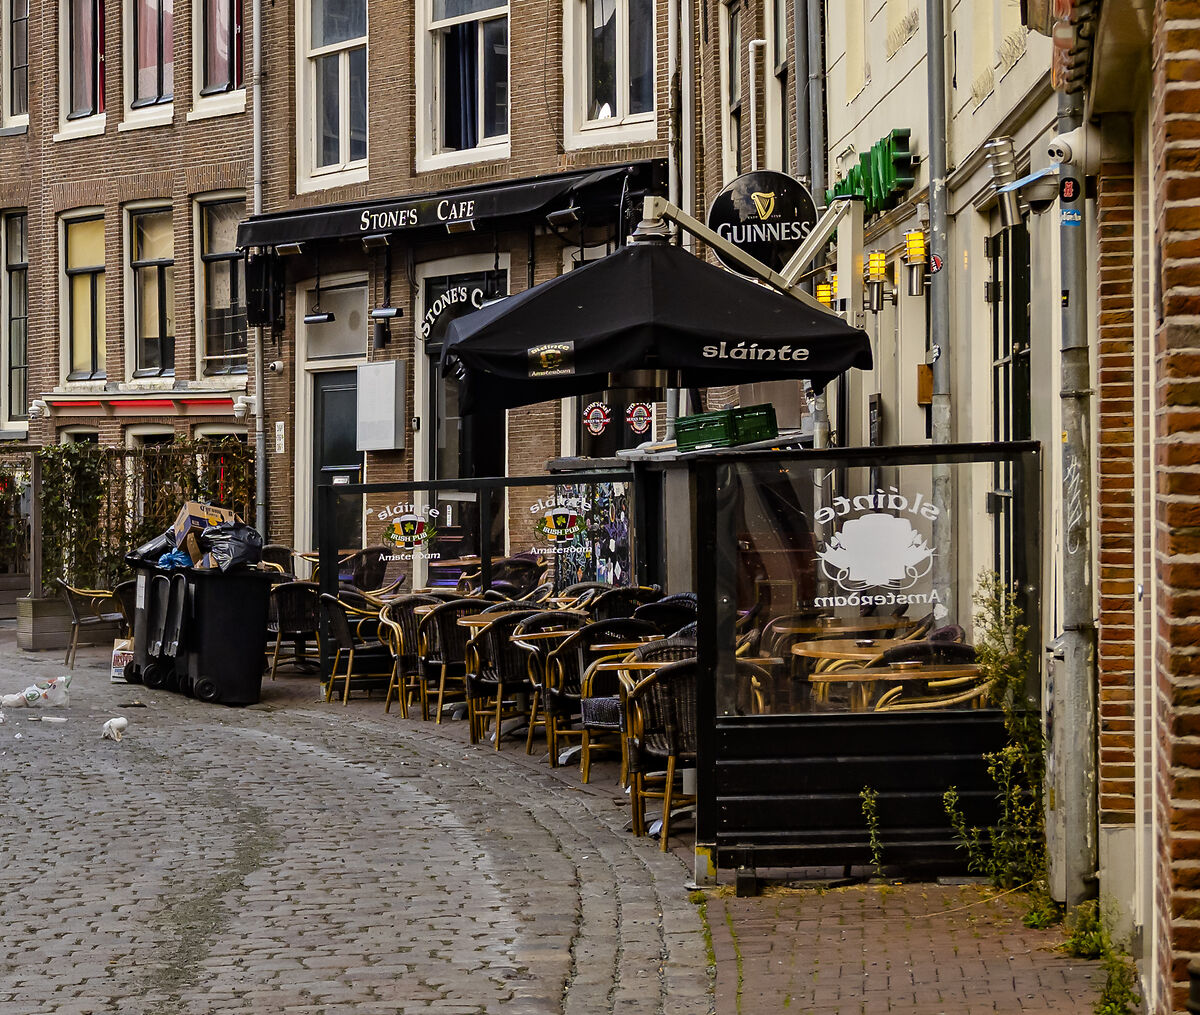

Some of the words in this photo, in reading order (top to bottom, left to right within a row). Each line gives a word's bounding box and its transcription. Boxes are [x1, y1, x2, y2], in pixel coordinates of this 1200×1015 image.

[360, 208, 418, 231] STONE'S
[437, 199, 475, 221] CAFE
[717, 221, 811, 244] GUINNESS
[420, 286, 468, 338] STONE'S
[702, 341, 810, 361] sláinte
[390, 533, 411, 542] IRISH
[412, 531, 428, 541] PUB
[564, 525, 580, 535] PUB
[378, 551, 441, 561] Amsterdam
[530, 545, 593, 555] Amsterdam
